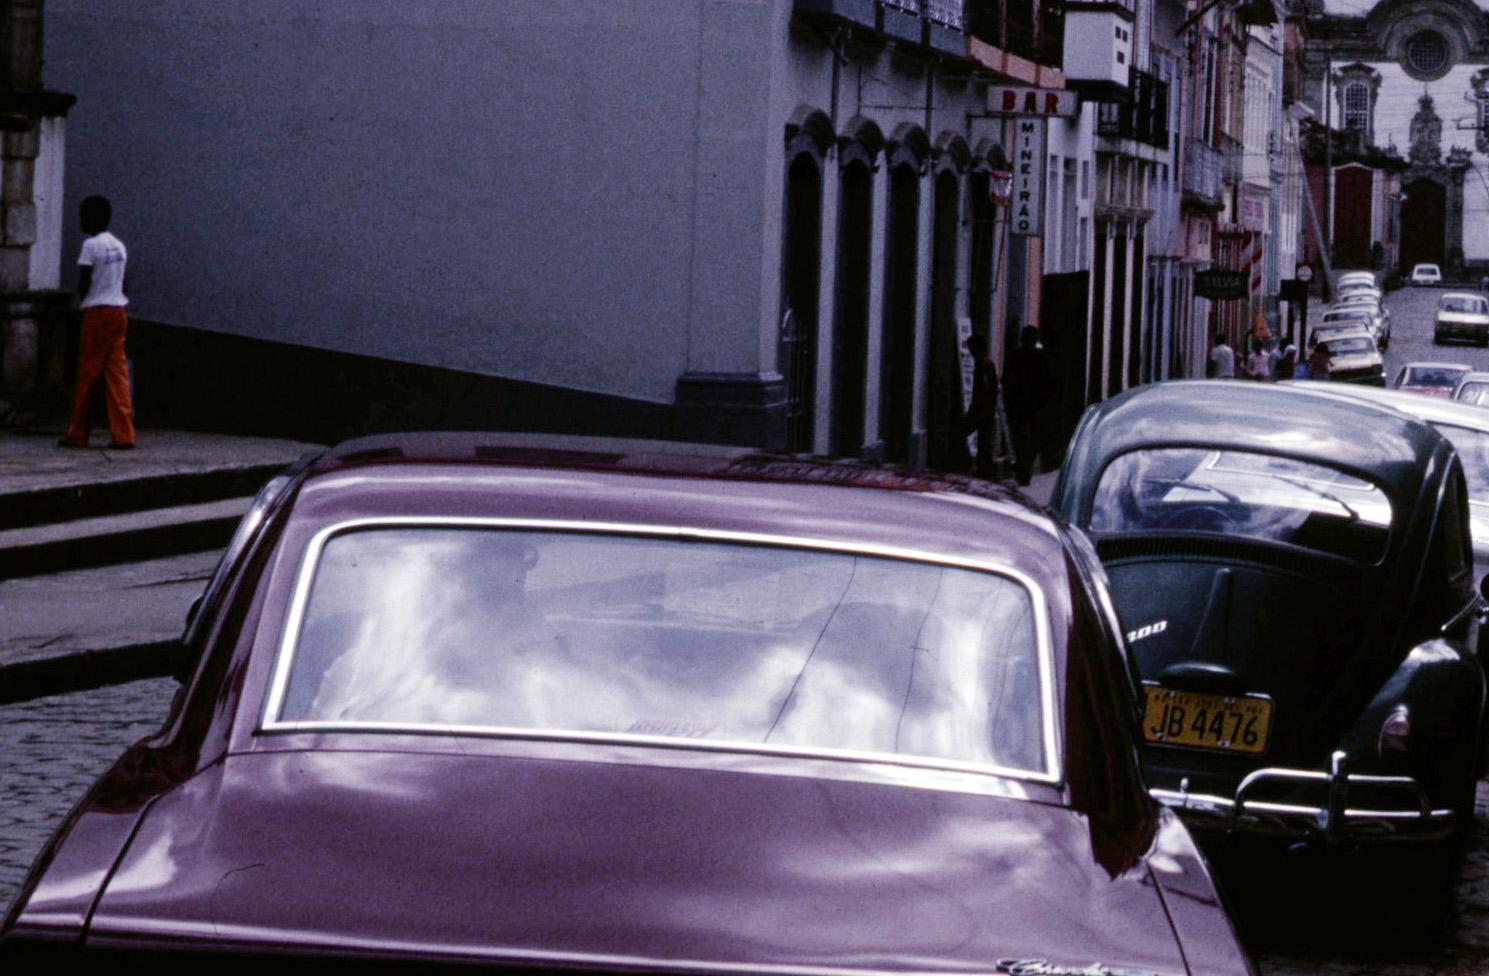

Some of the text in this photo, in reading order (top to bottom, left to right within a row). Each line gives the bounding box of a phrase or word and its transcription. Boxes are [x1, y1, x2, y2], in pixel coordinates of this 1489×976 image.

[1002, 90, 1059, 113] BAR
[1151, 704, 1259, 746] JB 4476
